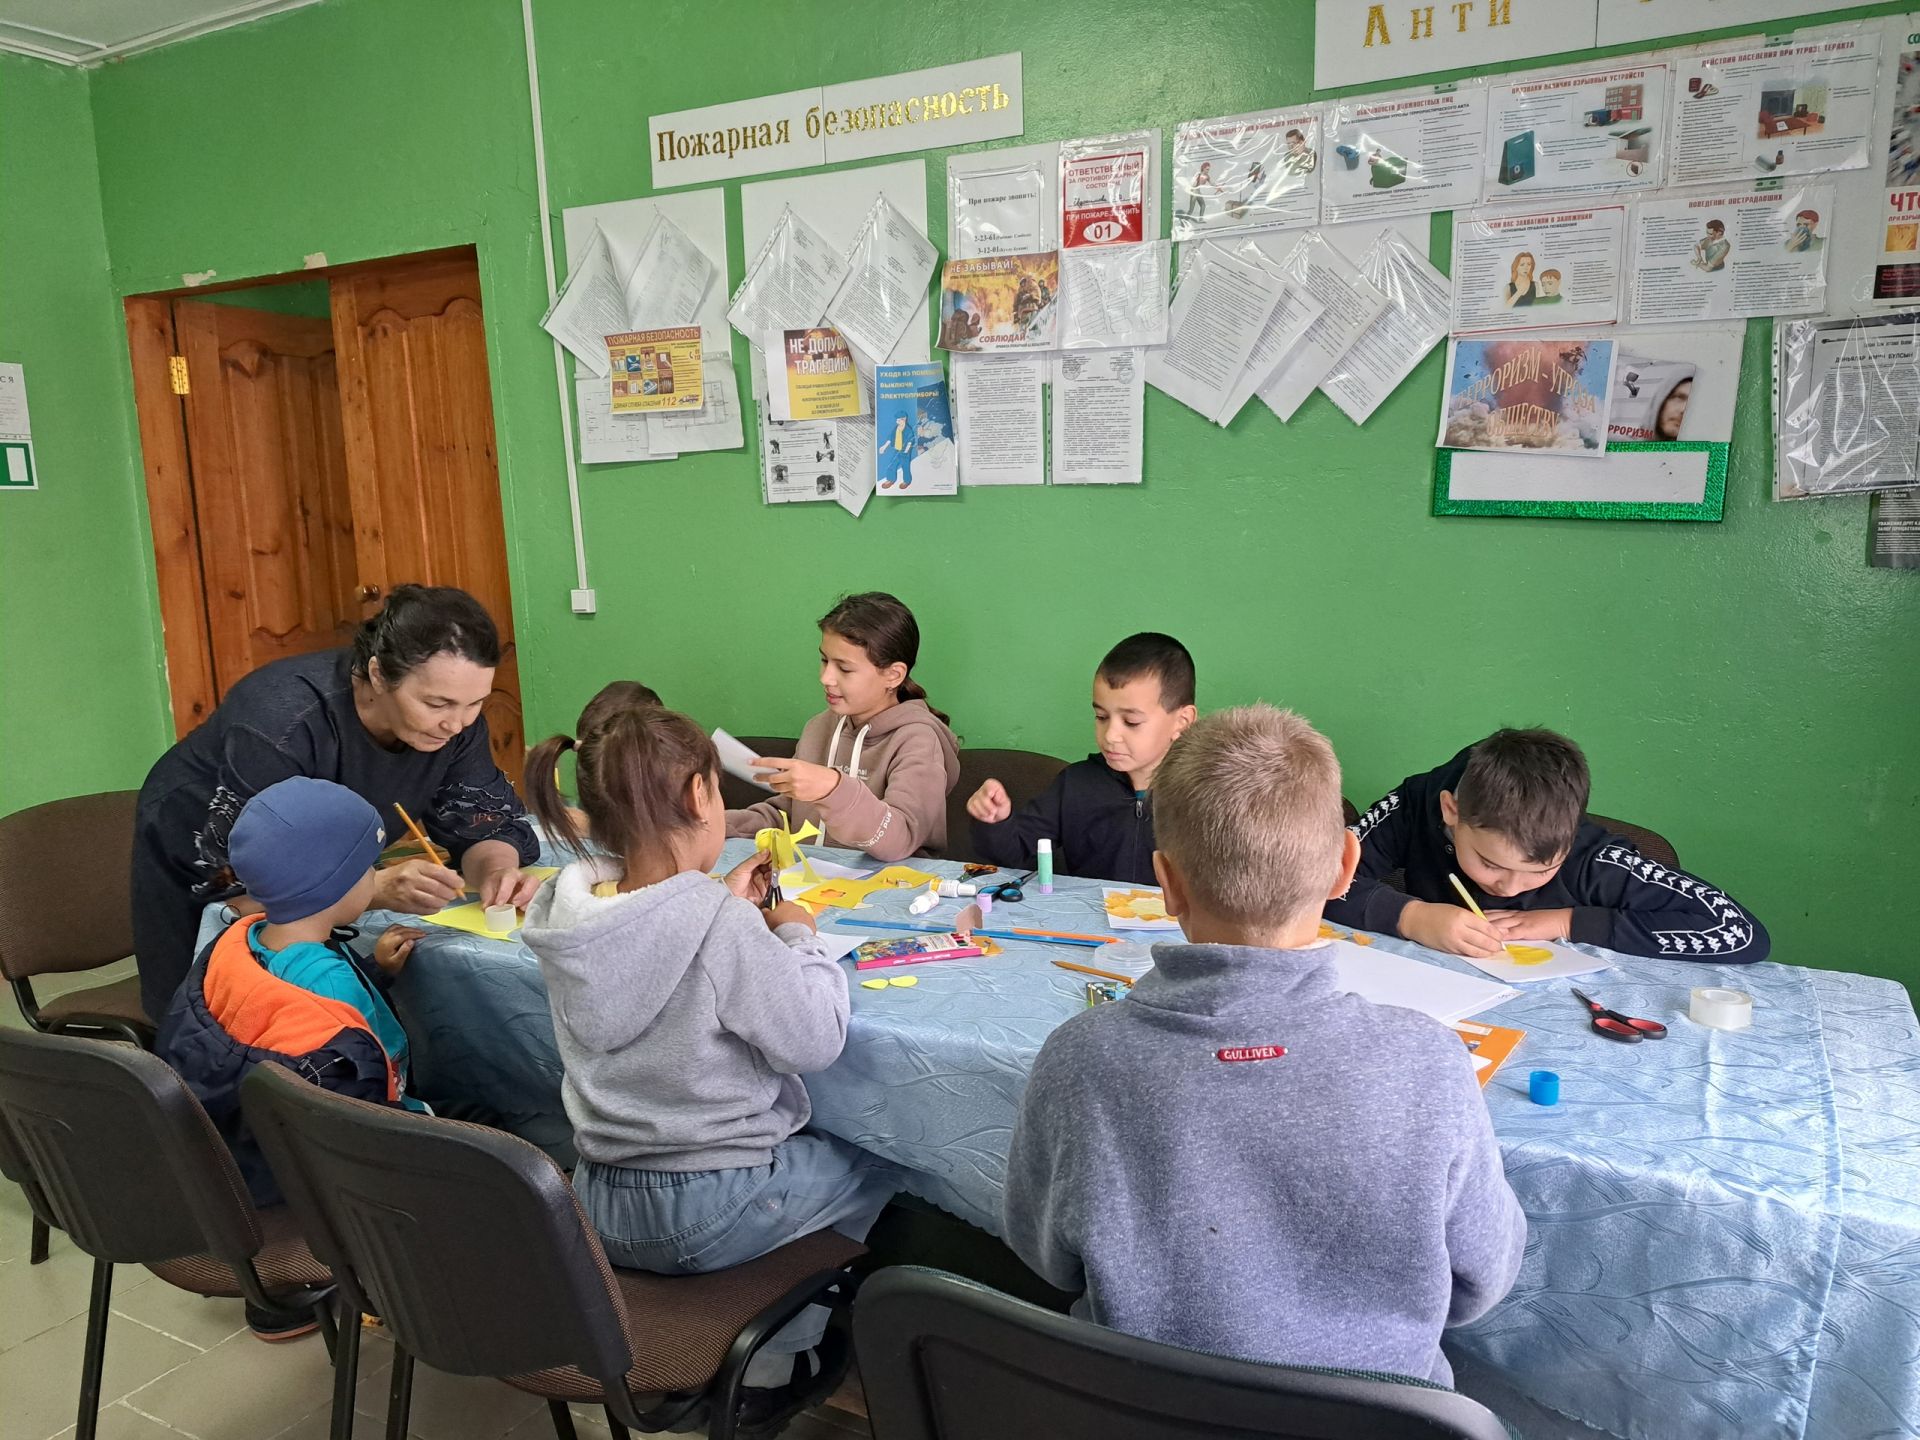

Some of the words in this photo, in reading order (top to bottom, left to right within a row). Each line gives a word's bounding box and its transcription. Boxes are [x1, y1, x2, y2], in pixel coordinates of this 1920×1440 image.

[1701, 57, 1735, 67] ДЕЙСТВИЯ
[1737, 51, 1777, 61] НАСЕЛЕНИЯ
[1780, 48, 1794, 57] ПРИ
[1824, 41, 1855, 52] ТЕРАКТА
[1610, 72, 1644, 82] УСТРОЙСТВ
[656, 119, 790, 163] Пожарная
[805, 83, 1009, 139] безопасность
[968, 198, 982, 206] При
[1688, 198, 1726, 209] ПОВЕДЕНИЕ
[1728, 193, 1783, 206] ПОСТРАДАВШИХ
[1890, 191, 1920, 213] ЧТ
[1080, 210, 1109, 220] ПОЖАРЕ
[1093, 223, 1112, 240] 01
[951, 263, 961, 273] НЕ
[964, 259, 1014, 273] ЗАБЫВАЙ!
[607, 332, 646, 345] ПОЖАРНАЯ
[646, 328, 699, 342] БЕЗОПАСНОСТЬ
[979, 333, 1026, 343] СОБЛЮДАЙ
[790, 338, 805, 354] НЕ
[795, 355, 850, 375] ТРАГЕДИЮ!
[1456, 346, 1543, 408] ТЕРРОРИЗМ
[1552, 361, 1596, 414] УГРОЗА
[662, 396, 677, 407] 112
[1486, 402, 1560, 437] ОБЩЕСТВУ
[1608, 424, 1653, 441] РРОРИЗМ
[1223, 1047, 1279, 1060] GULLIVER
